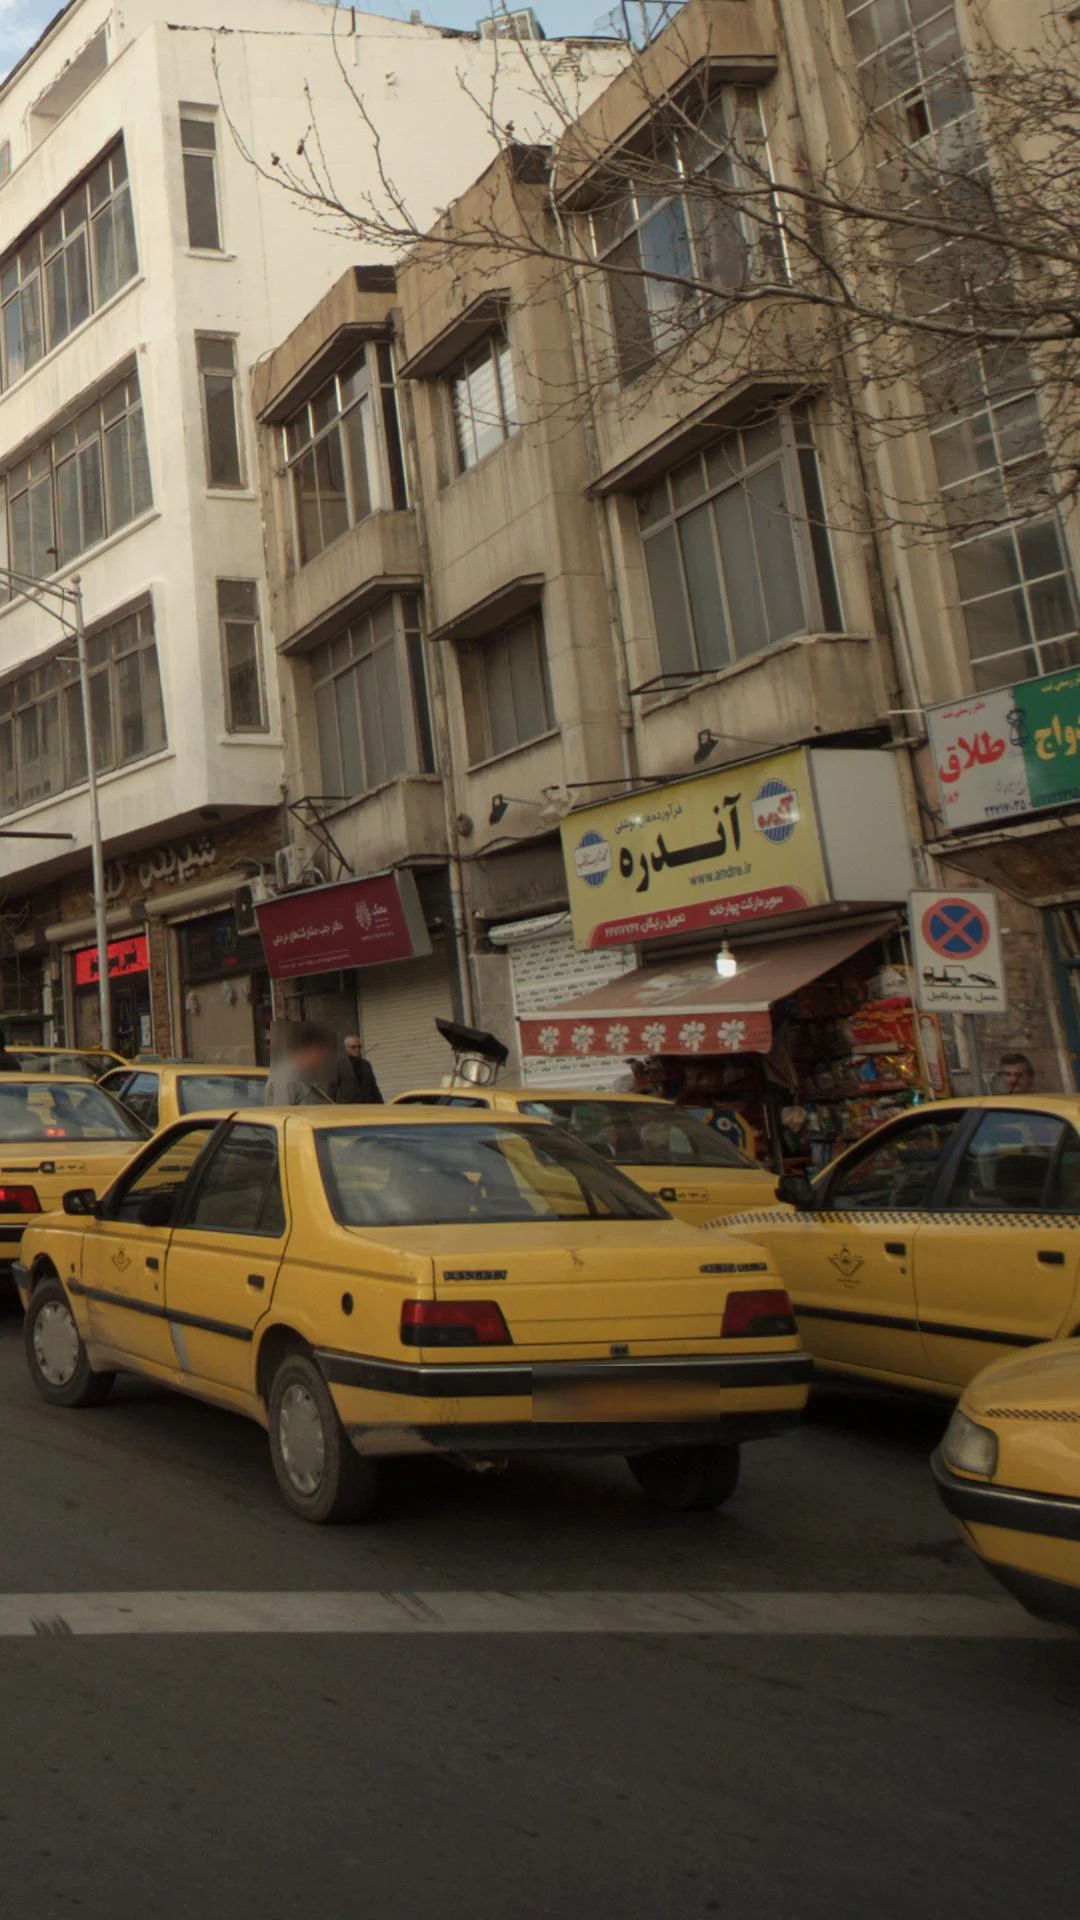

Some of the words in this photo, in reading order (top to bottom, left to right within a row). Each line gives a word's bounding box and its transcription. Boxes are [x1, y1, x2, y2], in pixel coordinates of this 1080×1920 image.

[939, 731, 1006, 784] طلاق
[620, 792, 741, 893] آندره
[688, 861, 753, 886] www.andre.ir
